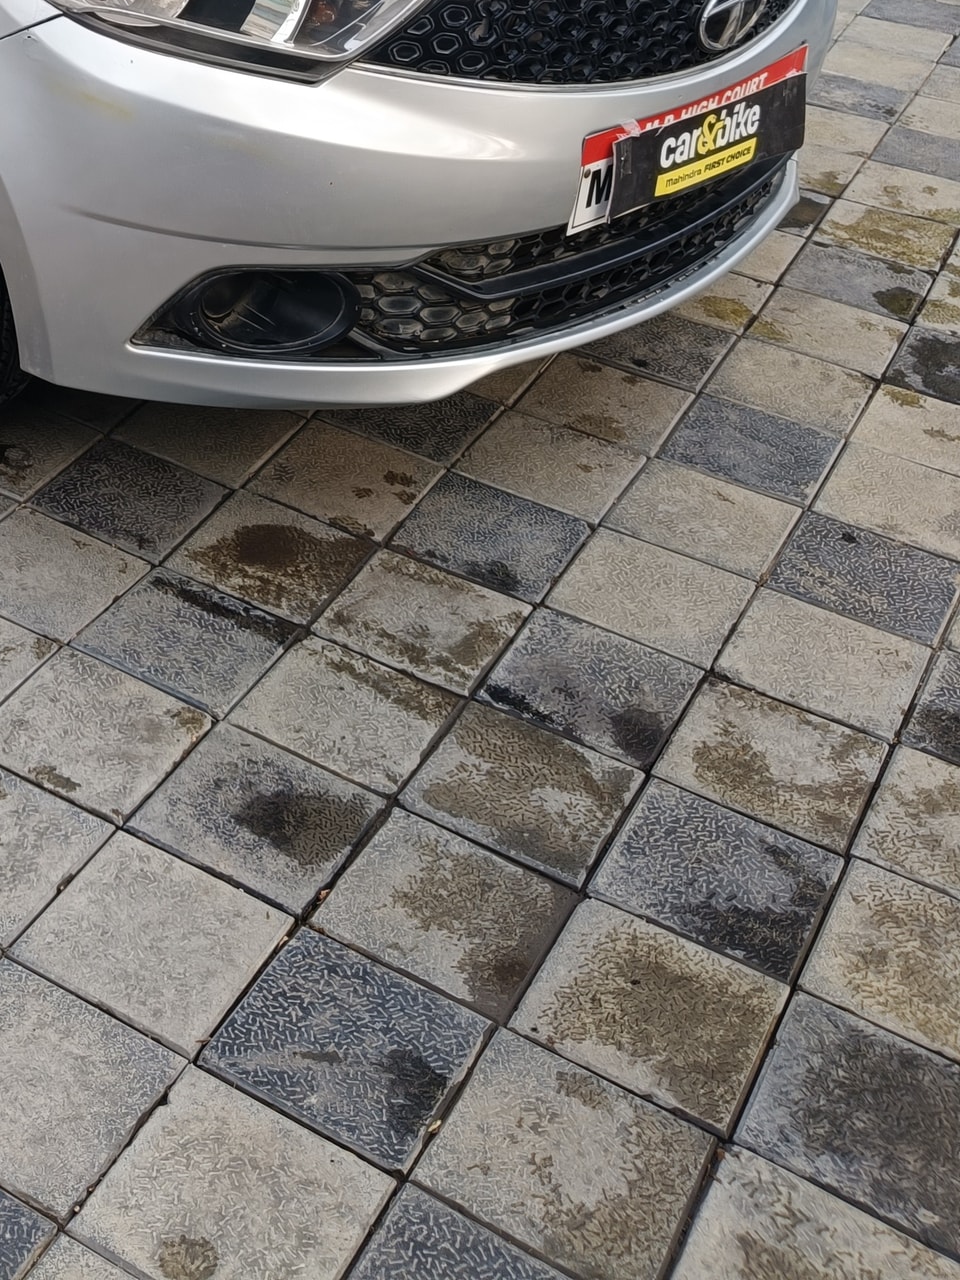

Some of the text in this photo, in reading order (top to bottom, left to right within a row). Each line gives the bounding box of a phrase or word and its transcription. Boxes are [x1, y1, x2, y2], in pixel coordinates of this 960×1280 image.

[722, 72, 768, 105] COURT
[660, 102, 760, 168] car&bike
[665, 145, 751, 188] Mahindra FIRST CHOICE
